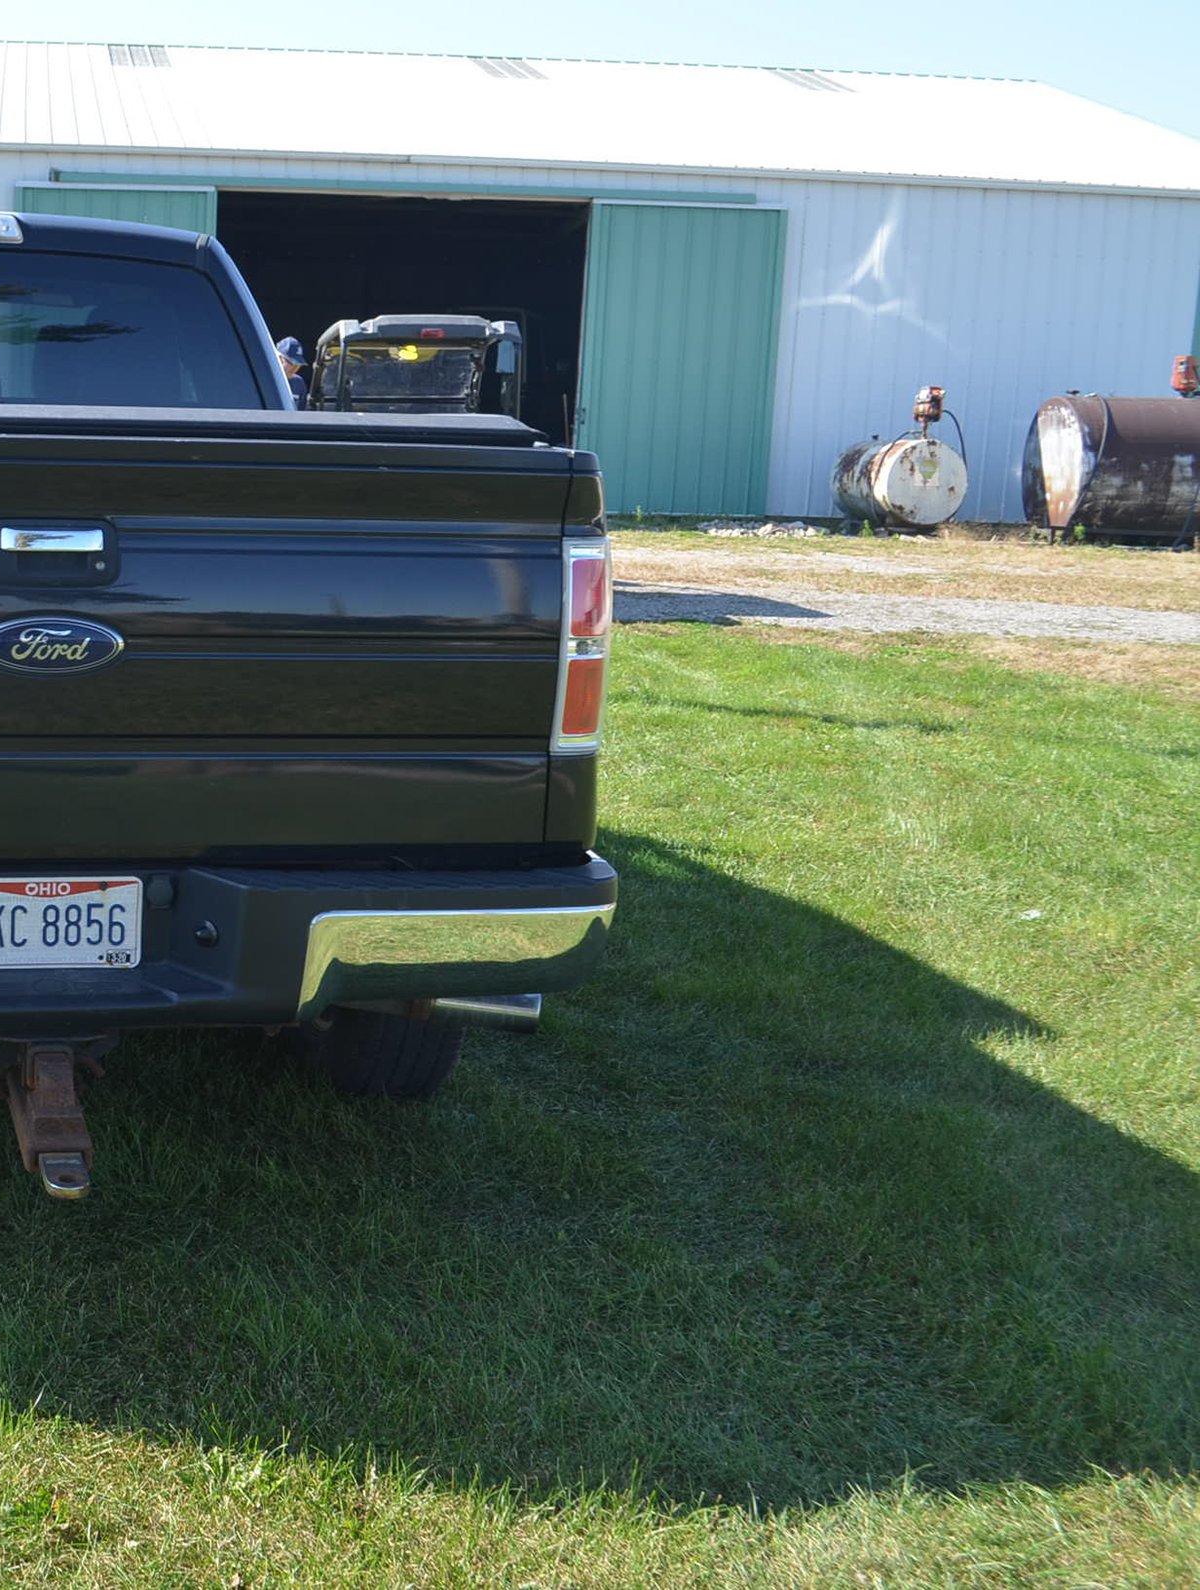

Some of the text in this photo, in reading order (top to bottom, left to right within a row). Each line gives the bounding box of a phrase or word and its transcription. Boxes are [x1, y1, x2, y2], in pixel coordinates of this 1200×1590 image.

[11, 627, 91, 661] Ford
[25, 882, 71, 896] OHIO
[42, 903, 126, 947] 8856
